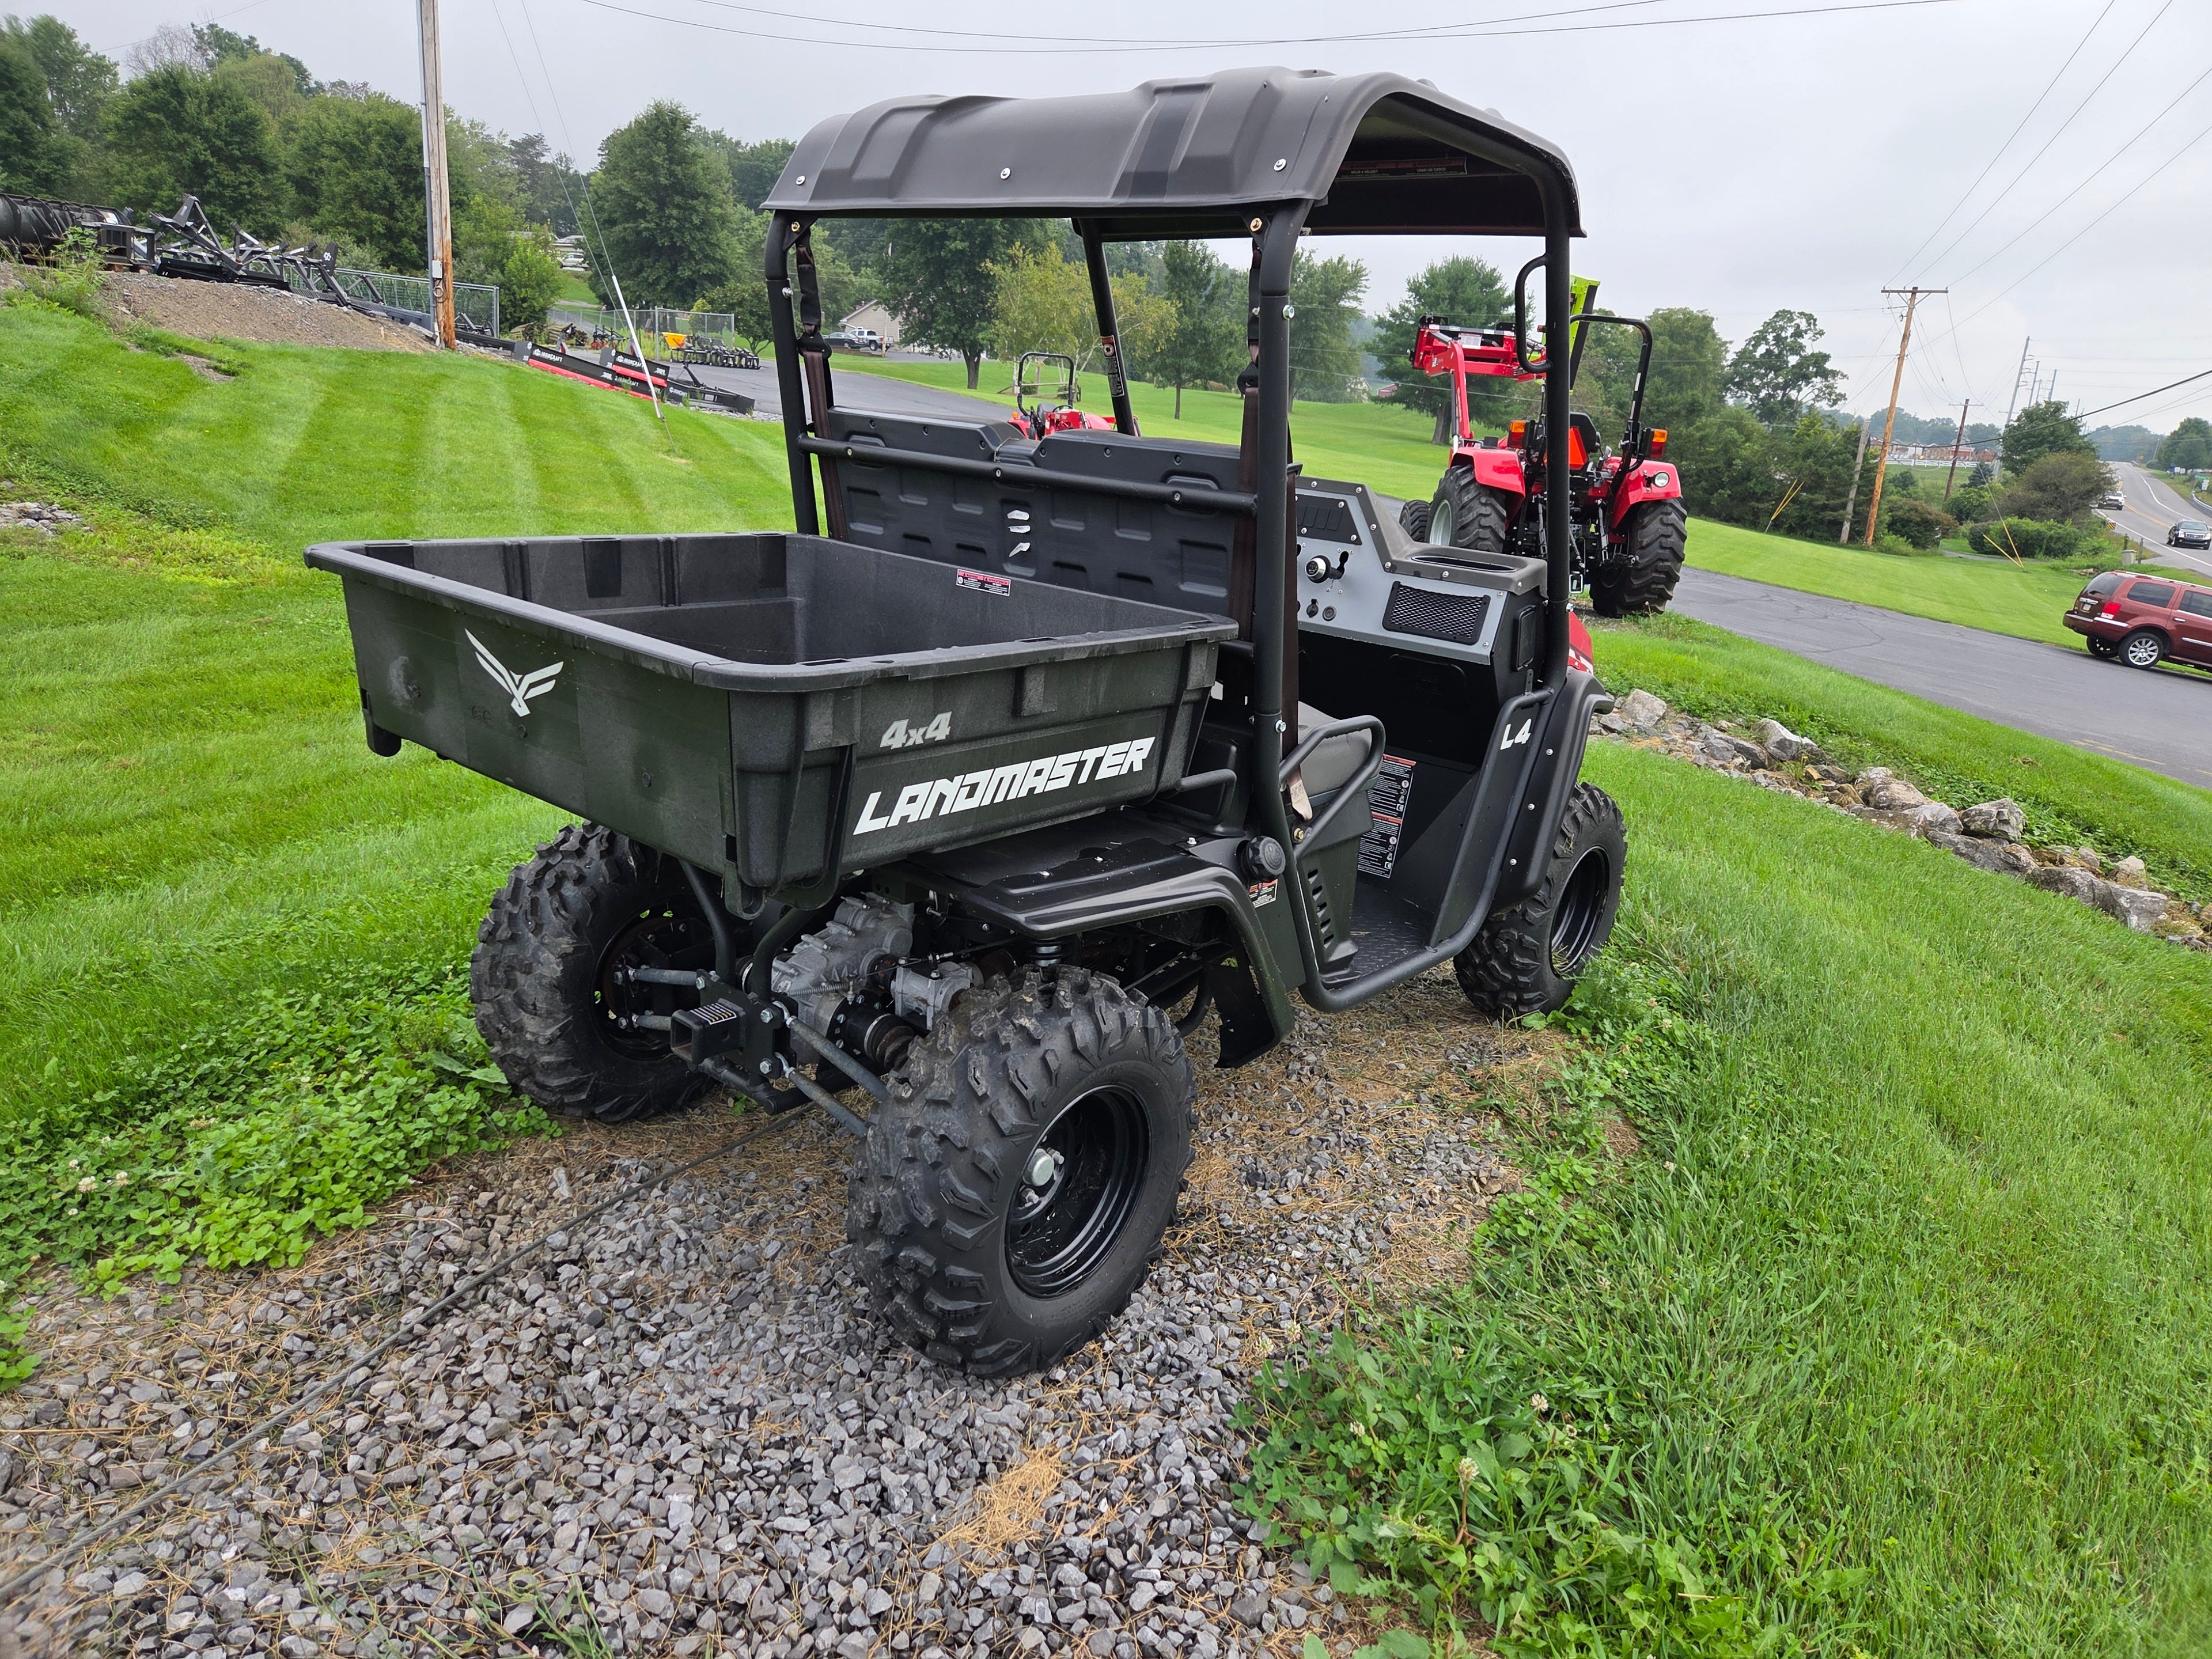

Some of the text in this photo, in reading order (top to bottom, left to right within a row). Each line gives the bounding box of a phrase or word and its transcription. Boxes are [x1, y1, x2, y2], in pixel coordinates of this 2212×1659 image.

[880, 711, 952, 749] 4x4
[1500, 718, 1532, 750] L4
[853, 736, 1156, 835] LANDMASTER
